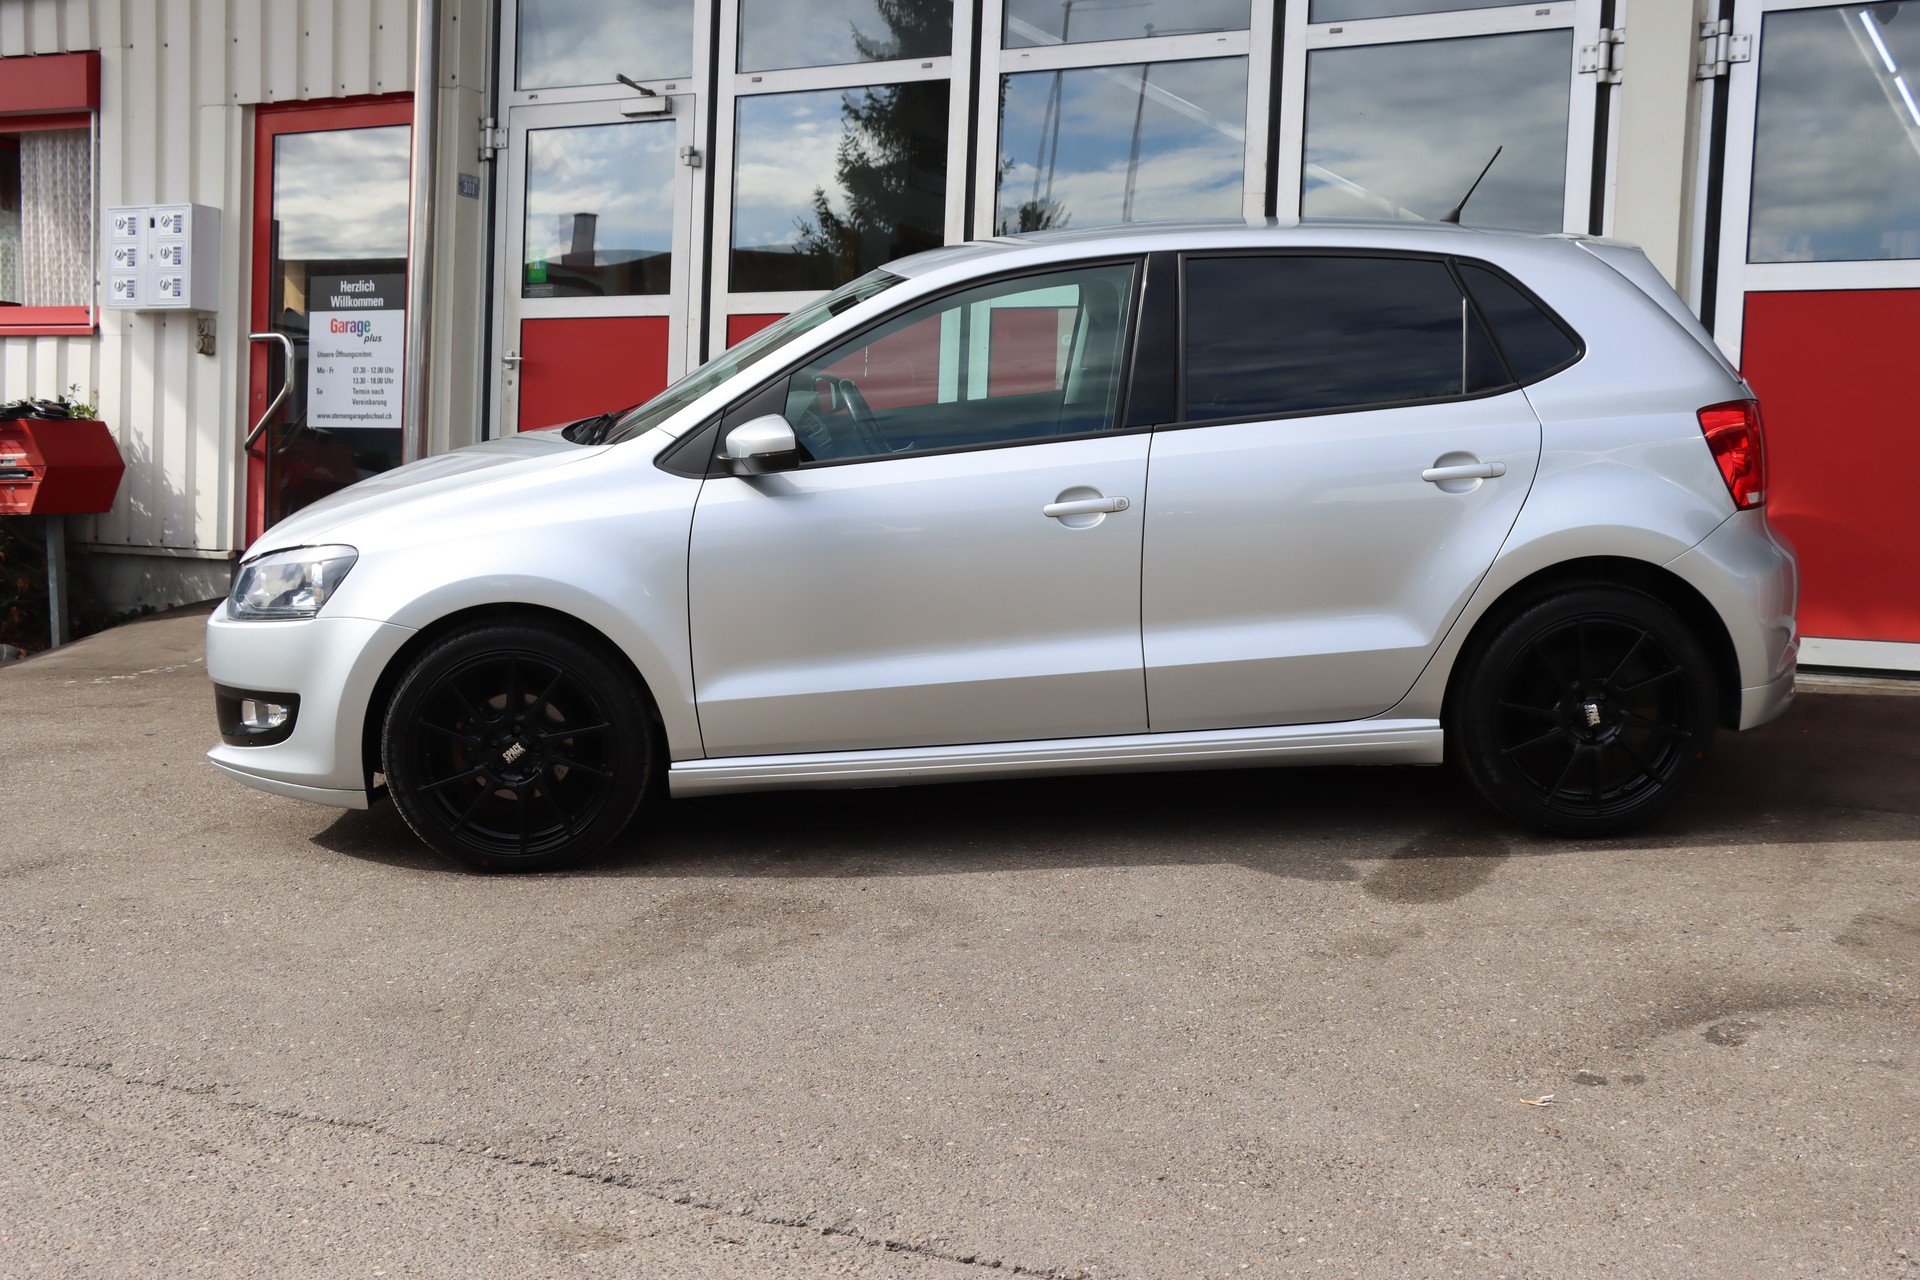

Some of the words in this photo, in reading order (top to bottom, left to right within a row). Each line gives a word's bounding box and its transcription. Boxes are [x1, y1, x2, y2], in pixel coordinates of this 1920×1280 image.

[463, 181, 475, 195] 301
[340, 280, 375, 292] Herzlich
[330, 295, 384, 308] Willkommen
[330, 318, 371, 337] Garage
[363, 334, 382, 344] plus
[316, 366, 325, 374] Mo
[329, 366, 334, 374] Fr
[352, 366, 366, 374] 07.30
[370, 366, 384, 374] 12.00
[384, 366, 394, 374] Uhr
[352, 377, 366, 385] 13.30
[370, 377, 384, 385] 18.00
[384, 377, 394, 385] Uhr
[316, 387, 323, 395] Sa
[352, 387, 370, 395] Termin
[371, 387, 384, 395] nach
[352, 398, 387, 407] Vereinbarung
[502, 742, 523, 762] SPACE
